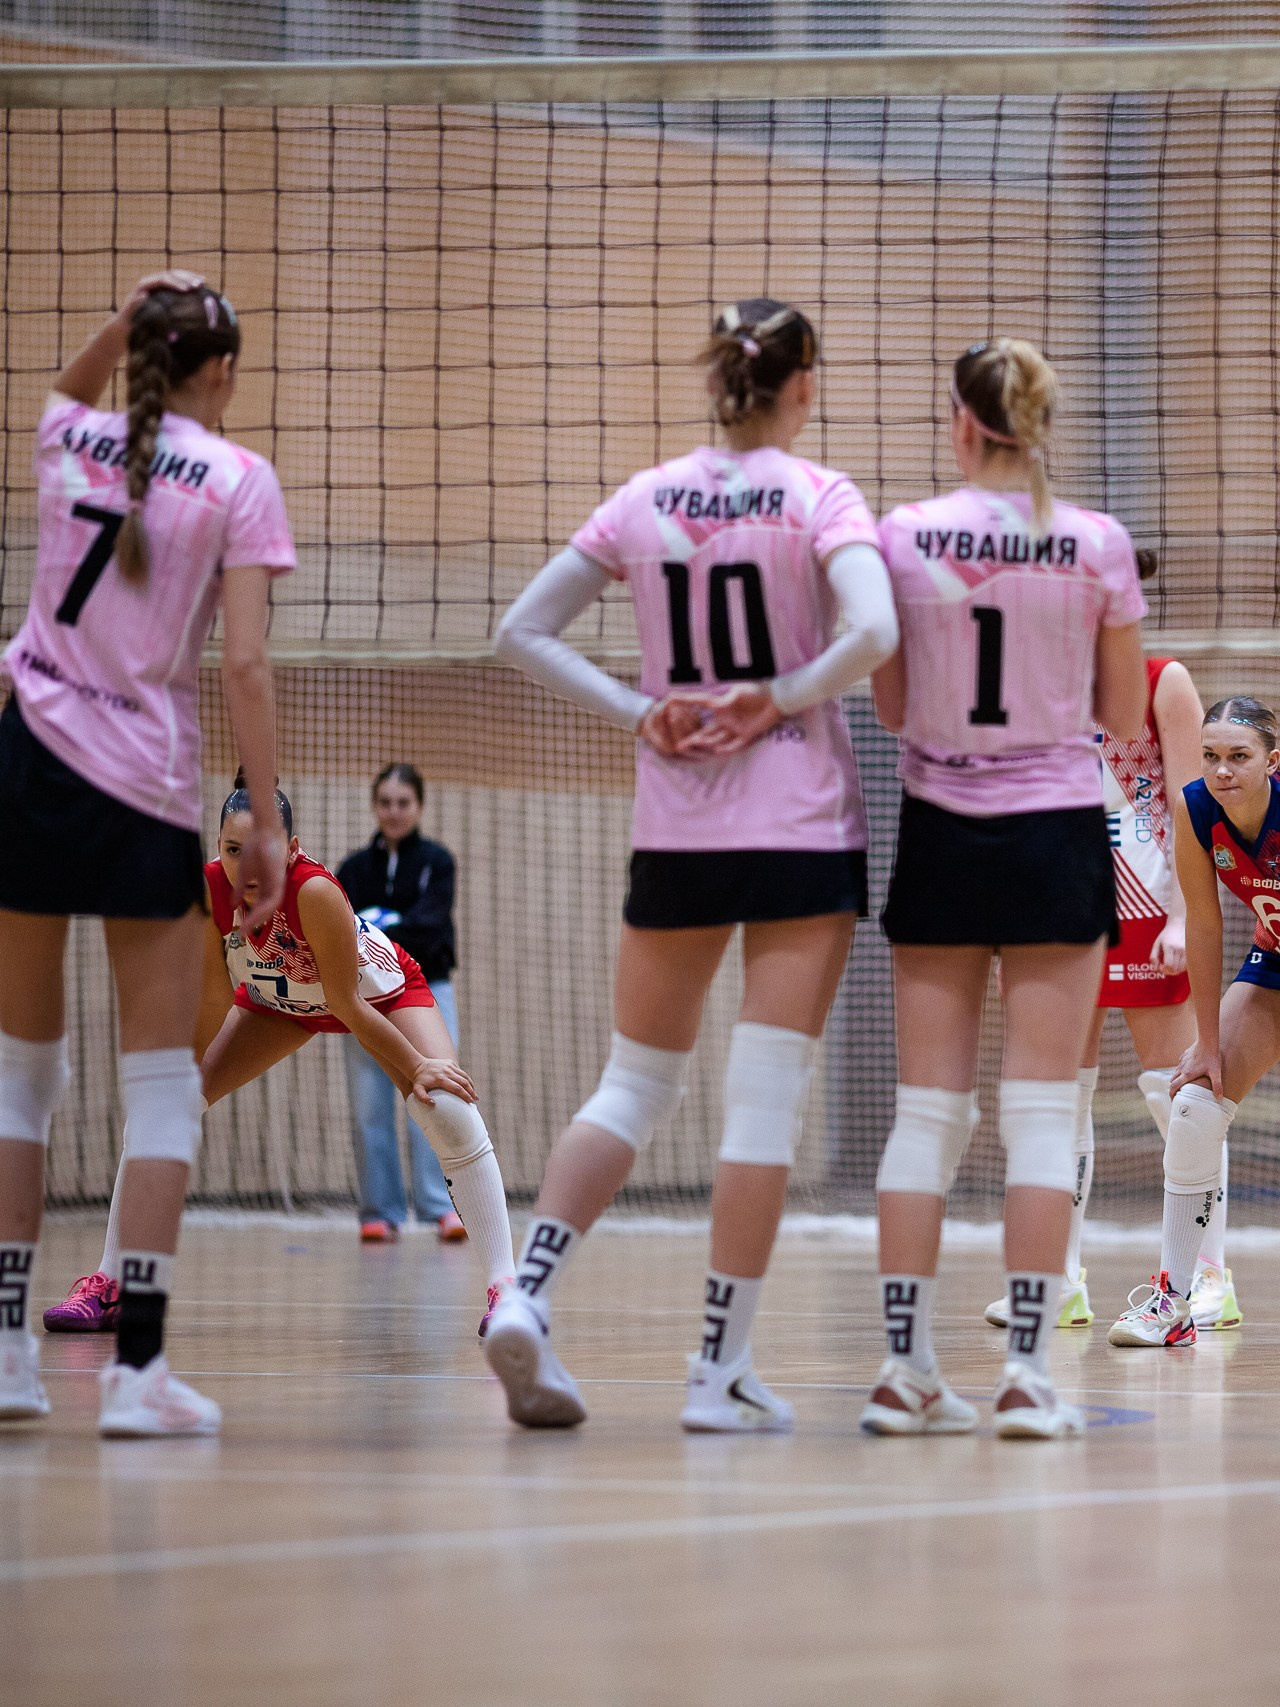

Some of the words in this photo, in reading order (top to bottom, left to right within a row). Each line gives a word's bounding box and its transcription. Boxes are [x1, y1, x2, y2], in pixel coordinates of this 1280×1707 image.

[654, 487, 784, 520] ЧУВАШИЯ
[56, 502, 124, 627] 7
[915, 530, 1077, 566] ЧУВАШИЯ
[662, 562, 776, 684] 10
[968, 606, 1009, 726] 1
[1135, 776, 1152, 843] A2MED
[256, 956, 284, 969] ВФВ
[1127, 971, 1166, 980] VISION
[251, 973, 289, 998] 7
